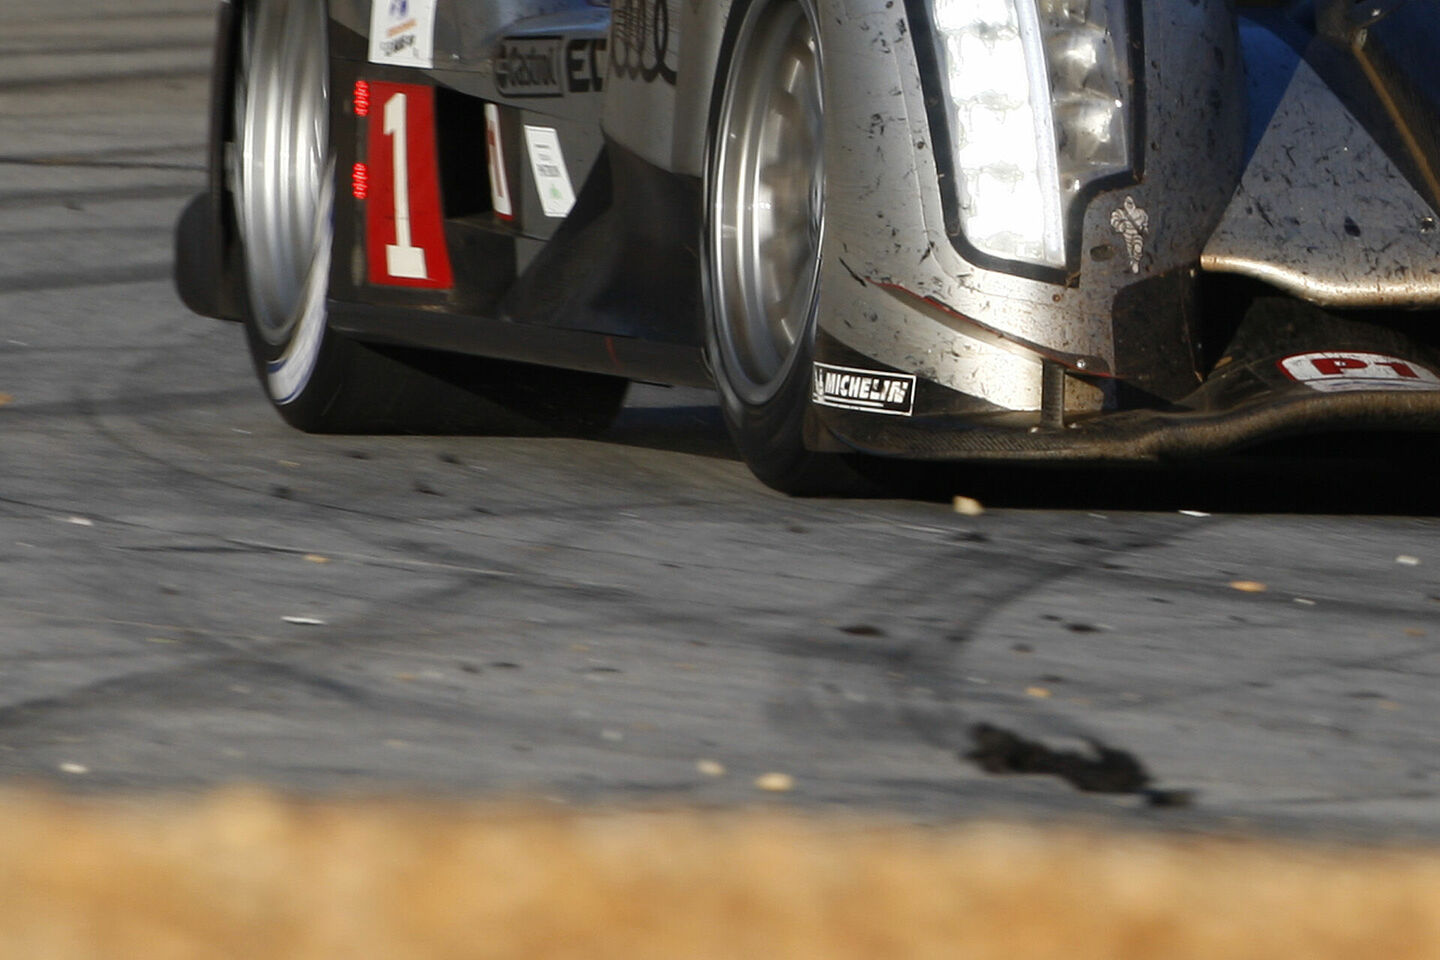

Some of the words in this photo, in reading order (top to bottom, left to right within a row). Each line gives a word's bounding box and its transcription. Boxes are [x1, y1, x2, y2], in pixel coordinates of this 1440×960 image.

[384, 93, 428, 280] 1
[1310, 357, 1421, 379] P1
[824, 372, 910, 404] MICHELIN
